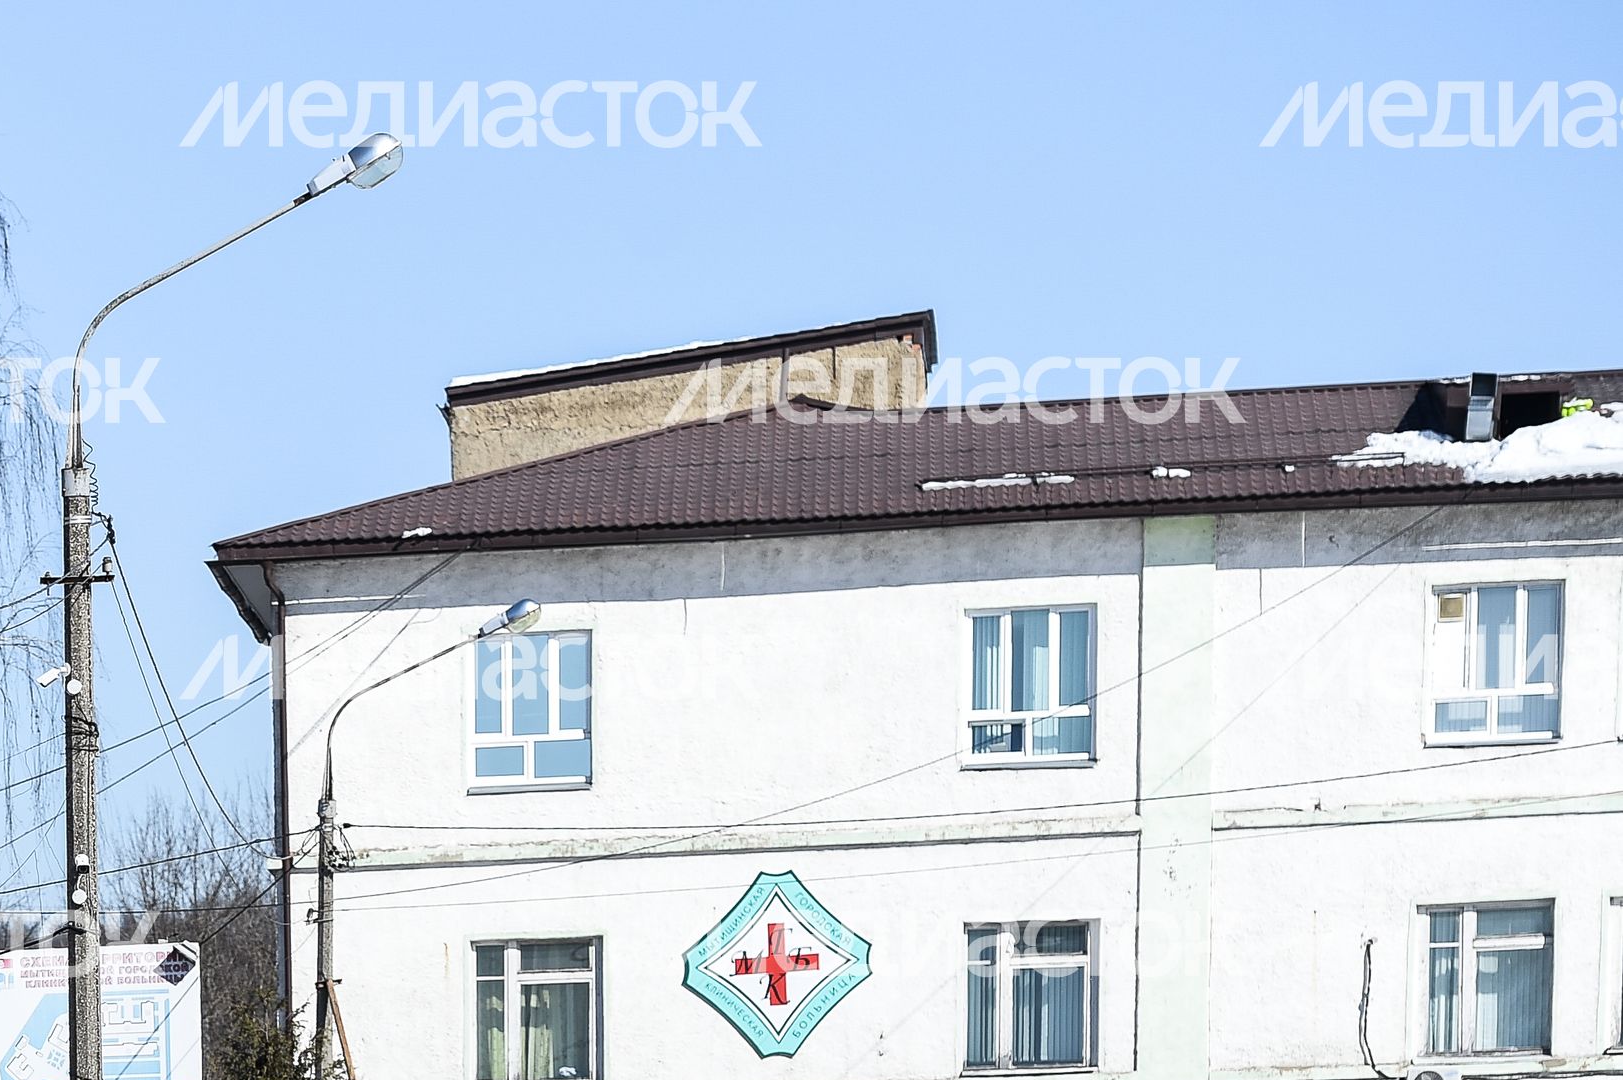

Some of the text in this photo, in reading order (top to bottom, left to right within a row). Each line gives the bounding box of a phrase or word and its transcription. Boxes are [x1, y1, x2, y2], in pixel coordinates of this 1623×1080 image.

[698, 887, 765, 957] МЫТИЩИНСКАЯ
[794, 891, 852, 945] ГОРОДСКАЯ
[20, 955, 68, 968] СХЕМ
[705, 983, 764, 1038] КЛИНИЧЕСКАЯ
[793, 973, 857, 1039] БОЛЬНИЦА
